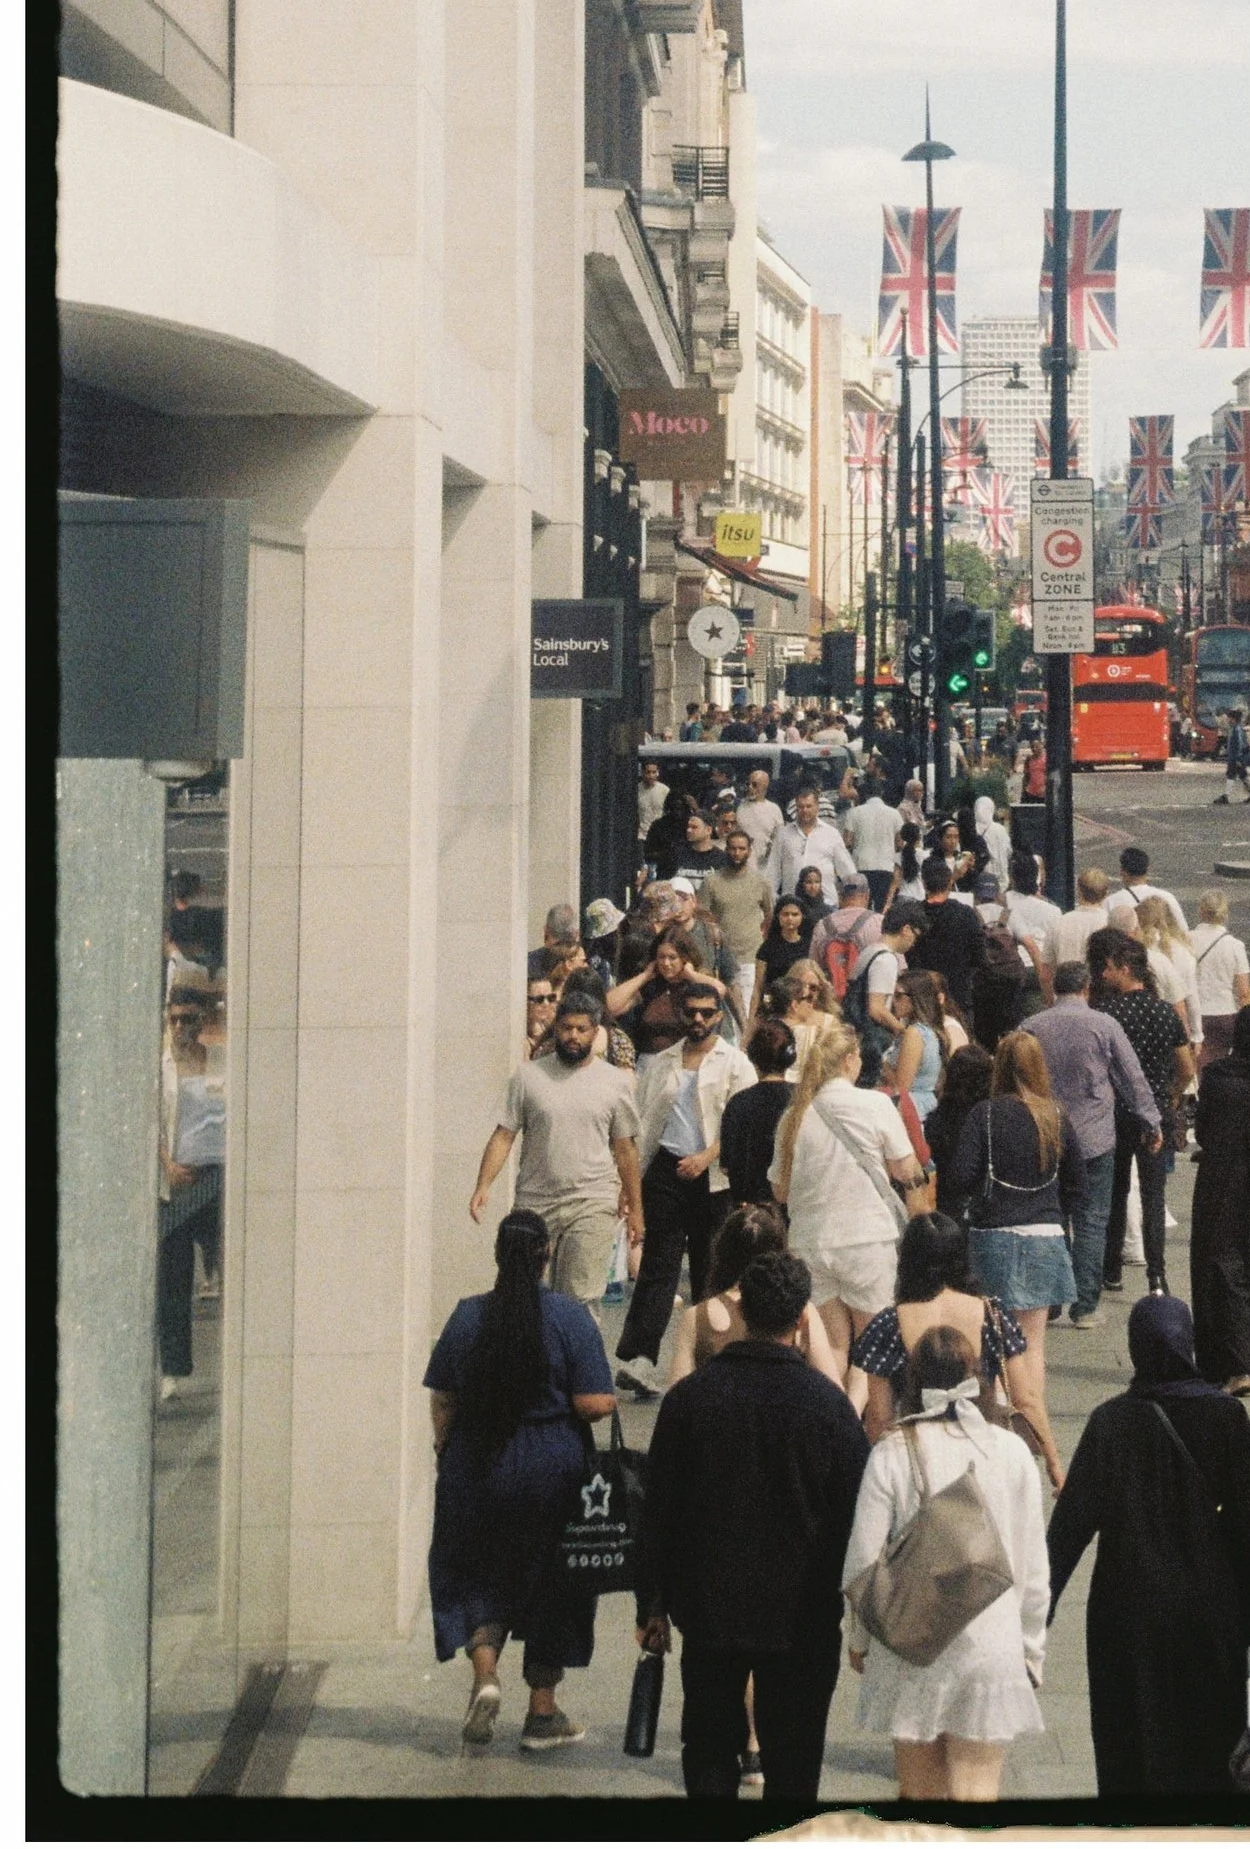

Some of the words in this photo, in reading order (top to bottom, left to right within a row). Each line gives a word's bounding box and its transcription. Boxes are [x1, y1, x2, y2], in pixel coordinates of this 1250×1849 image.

[629, 411, 710, 435] Moco
[1034, 507, 1089, 516] Congestion
[1041, 517, 1083, 526] charging
[722, 524, 755, 541] itsu
[1040, 572, 1087, 583] Central
[1045, 584, 1082, 595] ZONE
[533, 638, 609, 653] Sainsbury's
[533, 654, 569, 667] Local
